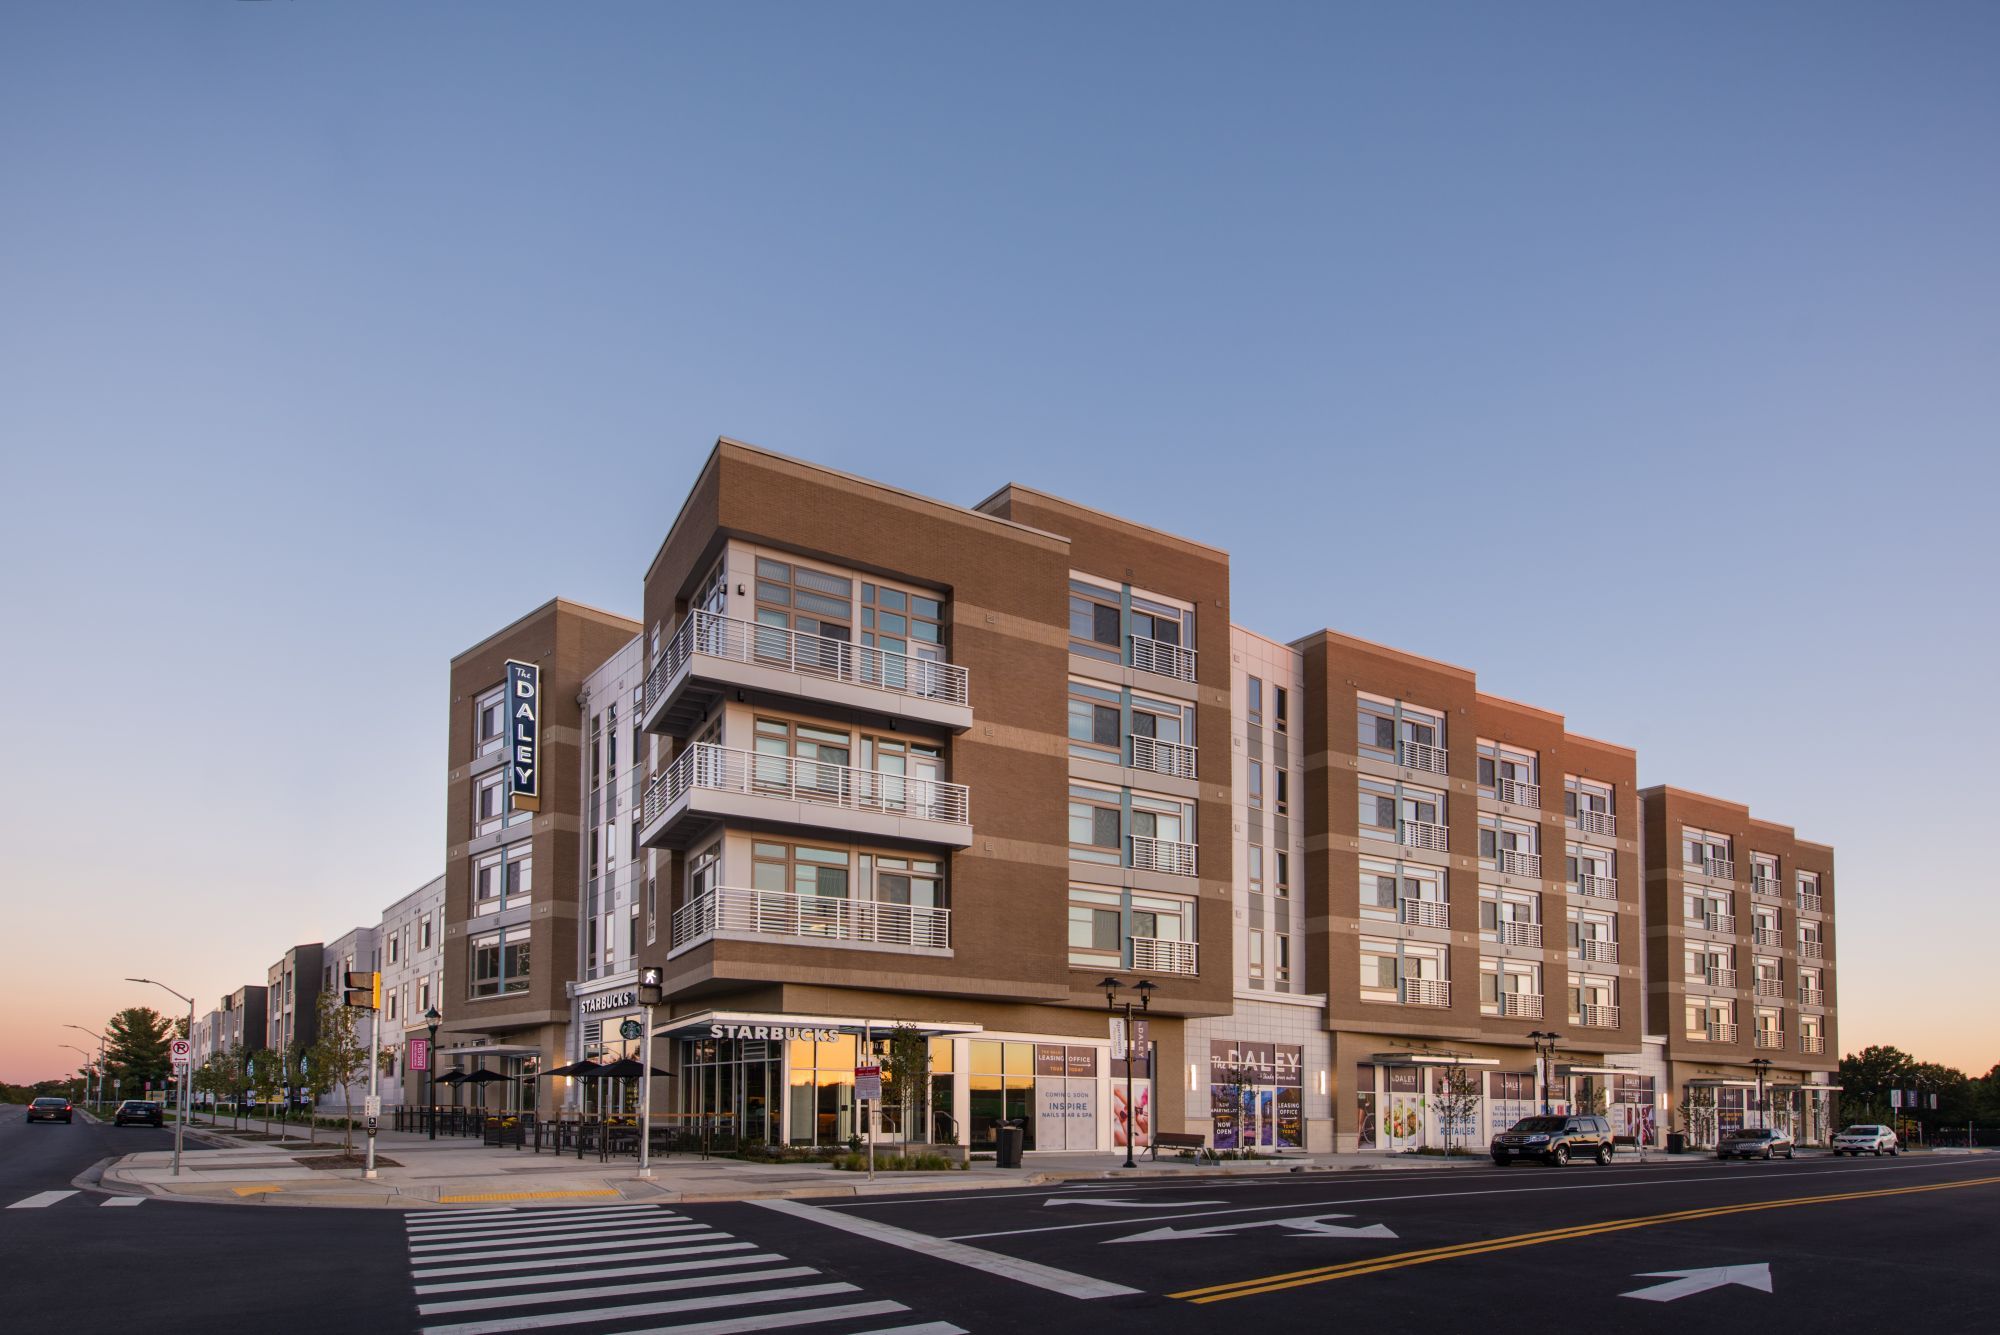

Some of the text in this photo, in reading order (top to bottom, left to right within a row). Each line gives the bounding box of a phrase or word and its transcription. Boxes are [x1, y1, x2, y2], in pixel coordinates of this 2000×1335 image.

[515, 667, 531, 679] The
[515, 680, 535, 784] DALEY
[581, 992, 629, 1014] STARBUCKS
[710, 1024, 840, 1043] STARBUCKS
[1038, 1054, 1065, 1062] LEASING
[1228, 1049, 1300, 1073] DALEY
[1049, 1102, 1088, 1111] INSPIRE
[1279, 1108, 1299, 1116] OFFICE
[1217, 1121, 1231, 1129] NOW
[1440, 1127, 1476, 1136] RETAILER
